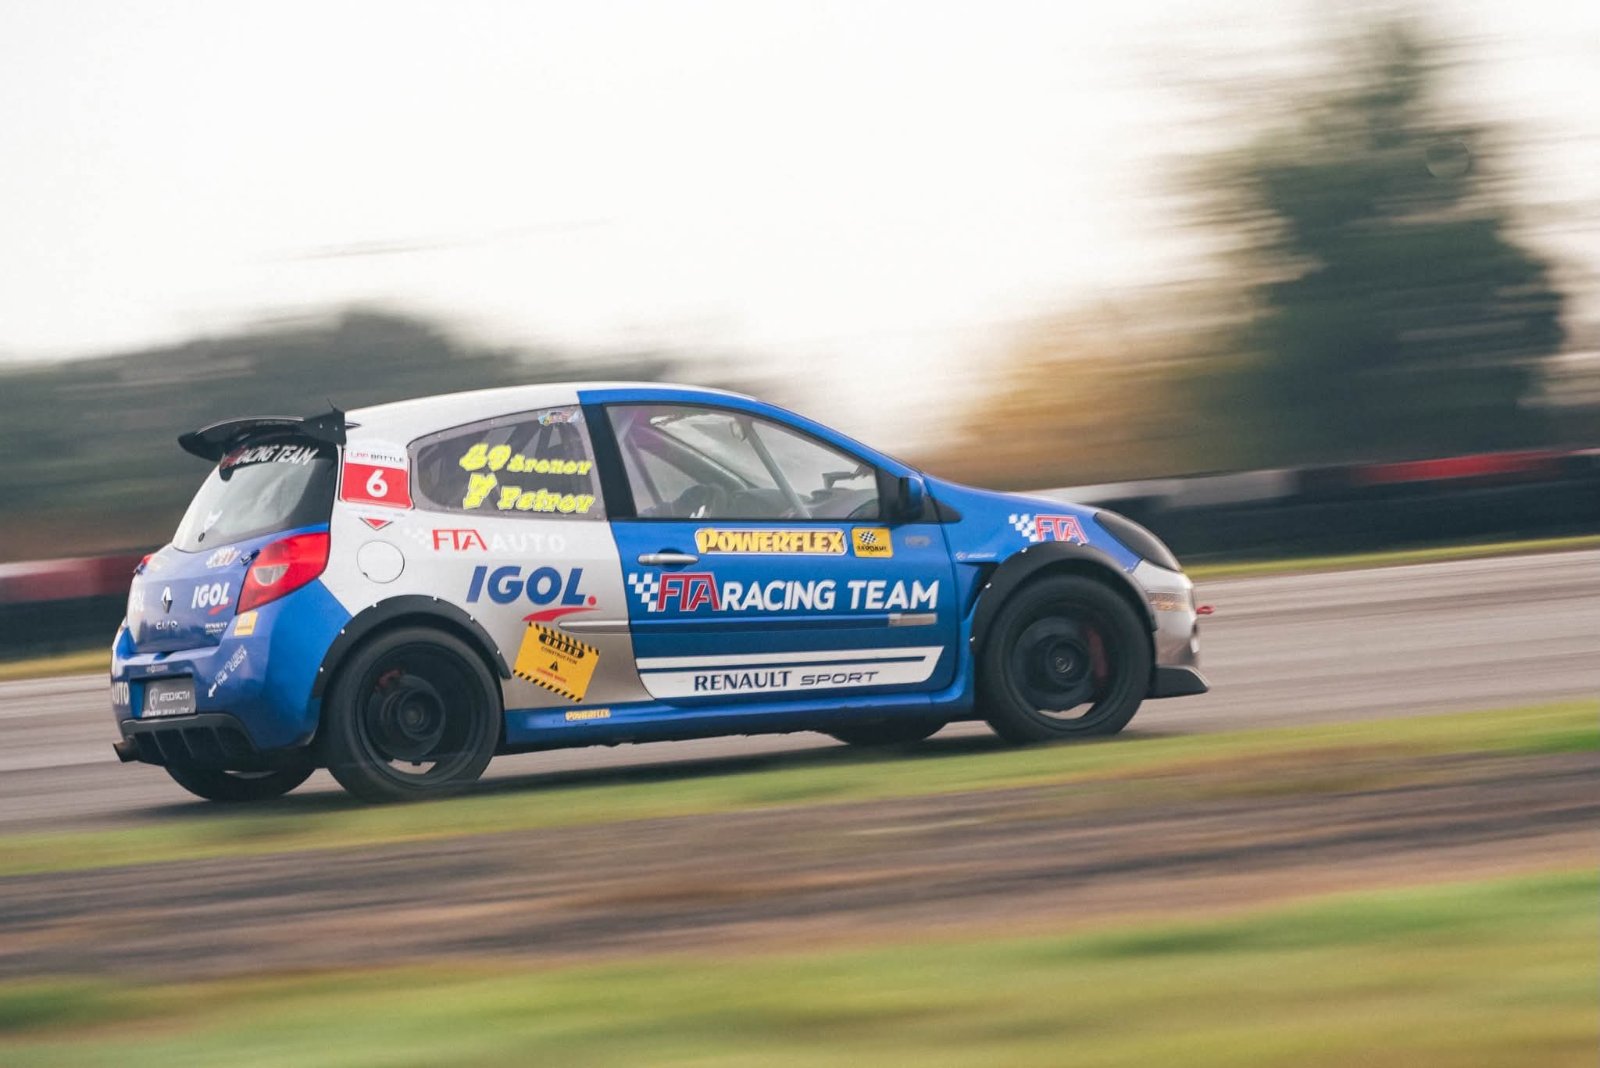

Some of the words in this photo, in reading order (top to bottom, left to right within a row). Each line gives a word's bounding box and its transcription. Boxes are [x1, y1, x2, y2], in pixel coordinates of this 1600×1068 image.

[273, 445, 319, 465] TEAM
[370, 453, 404, 462] BATTLE
[366, 469, 388, 498] 6
[432, 529, 488, 551] FTA
[491, 533, 566, 553] AUTO
[698, 528, 846, 553] POWERFLEX
[1033, 514, 1089, 543] FTA
[191, 582, 230, 609] IGOL
[656, 571, 722, 612] FTA
[721, 580, 837, 611] RACING
[847, 580, 940, 610] TEAM
[693, 670, 792, 692] RENAULT
[799, 671, 880, 686] SPORT
